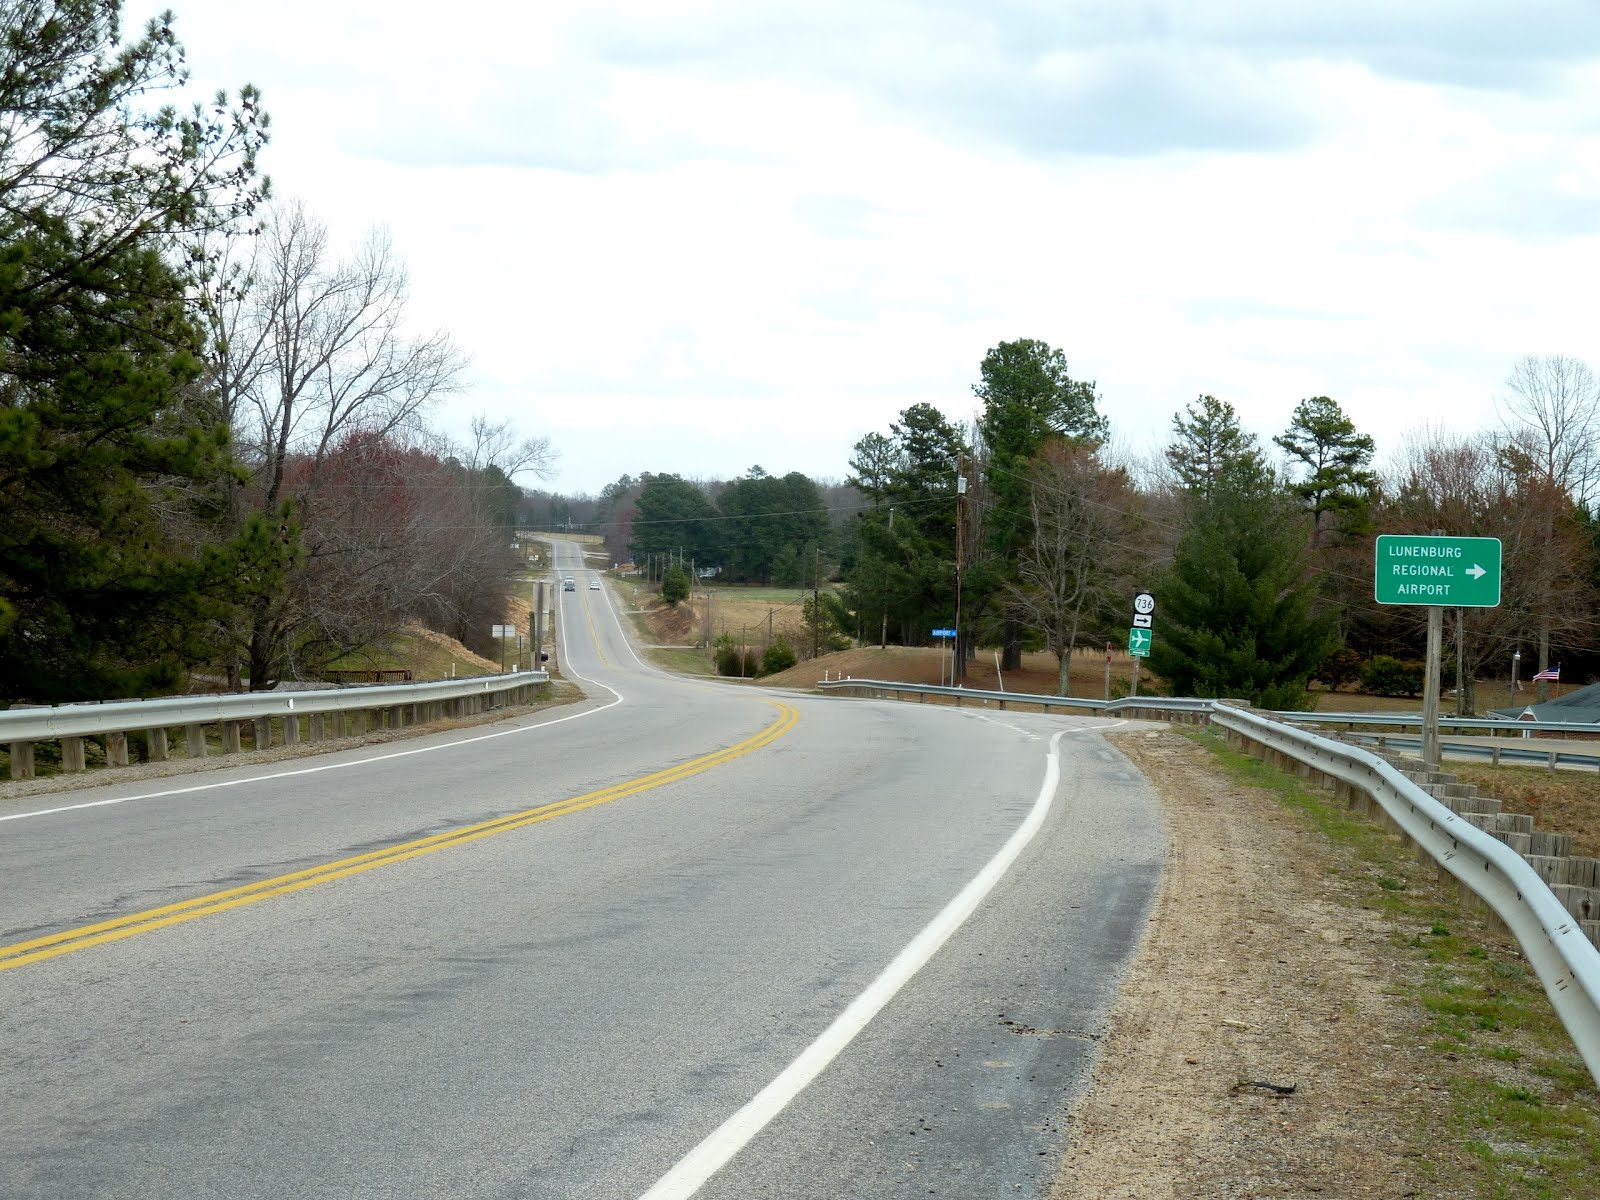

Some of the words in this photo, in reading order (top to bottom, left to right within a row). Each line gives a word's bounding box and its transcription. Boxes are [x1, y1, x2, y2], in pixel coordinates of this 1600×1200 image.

[1389, 545, 1462, 558] LUNENBURG
[1392, 564, 1454, 577] REGIONAL
[1397, 584, 1451, 595] AIRPORT
[1136, 598, 1153, 609] 736
